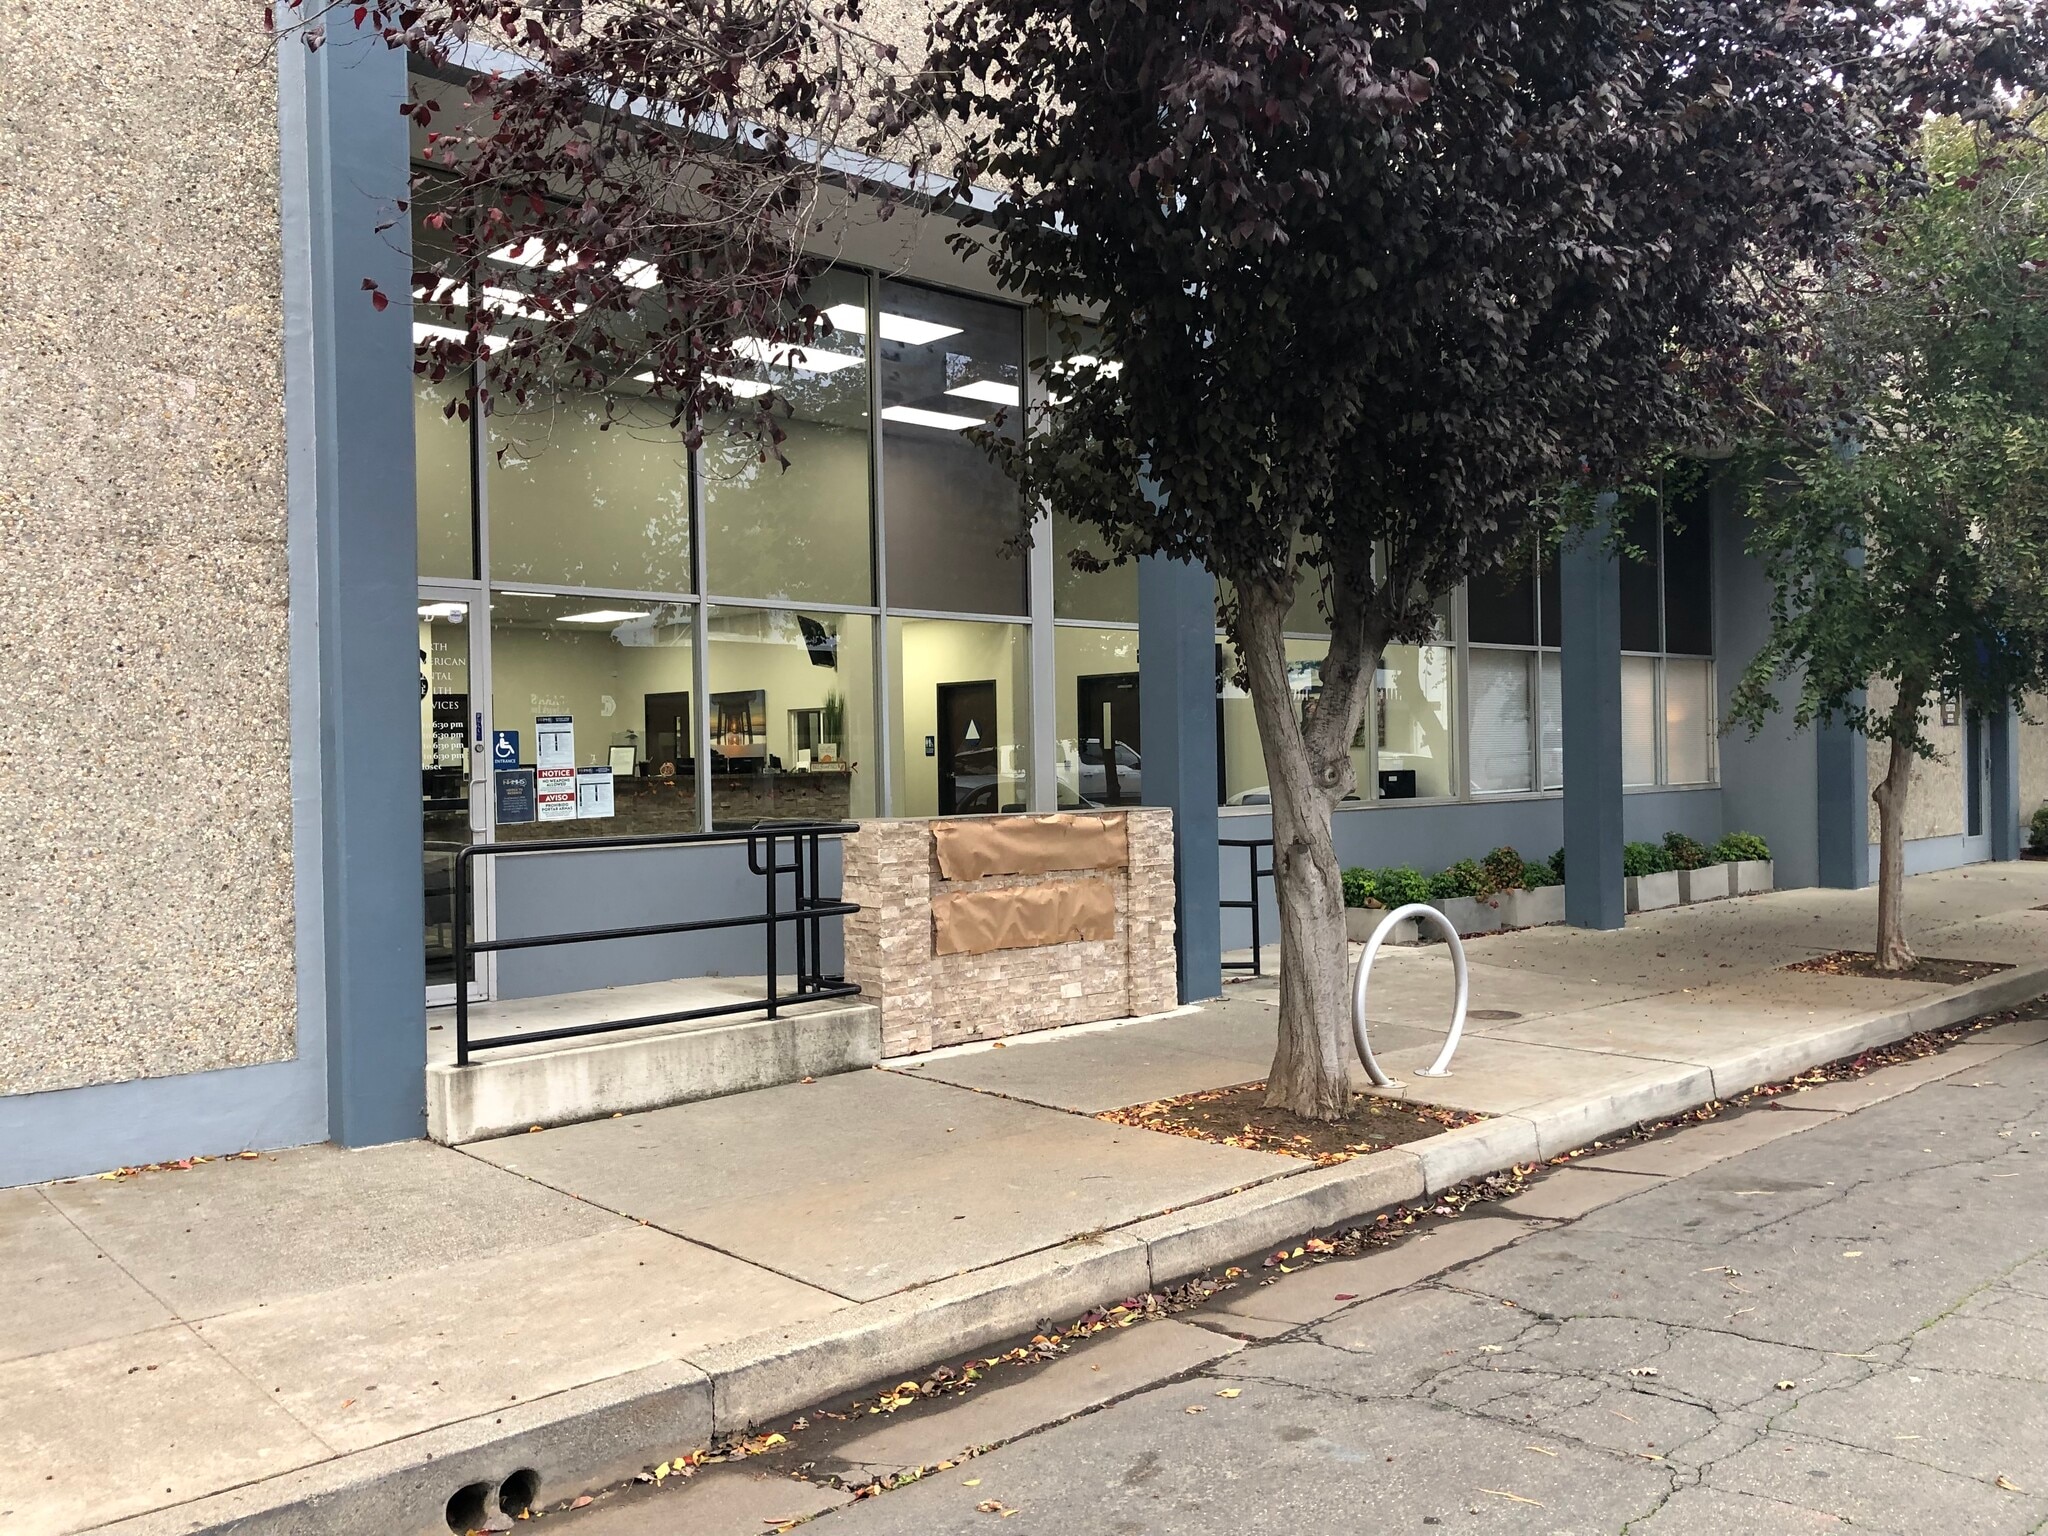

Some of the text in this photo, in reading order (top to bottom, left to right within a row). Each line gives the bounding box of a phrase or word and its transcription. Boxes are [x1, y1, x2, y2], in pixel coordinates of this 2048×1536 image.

[432, 721, 449, 730] 6:30
[450, 722, 464, 730] pm
[432, 731, 449, 740] 6:30
[450, 732, 464, 740] pm
[432, 742, 450, 751] 6:30
[450, 743, 464, 751] pm
[433, 752, 450, 762] 6:30
[451, 753, 465, 761] pm
[542, 769, 571, 777] NOTICE
[545, 794, 569, 802] AVISO
